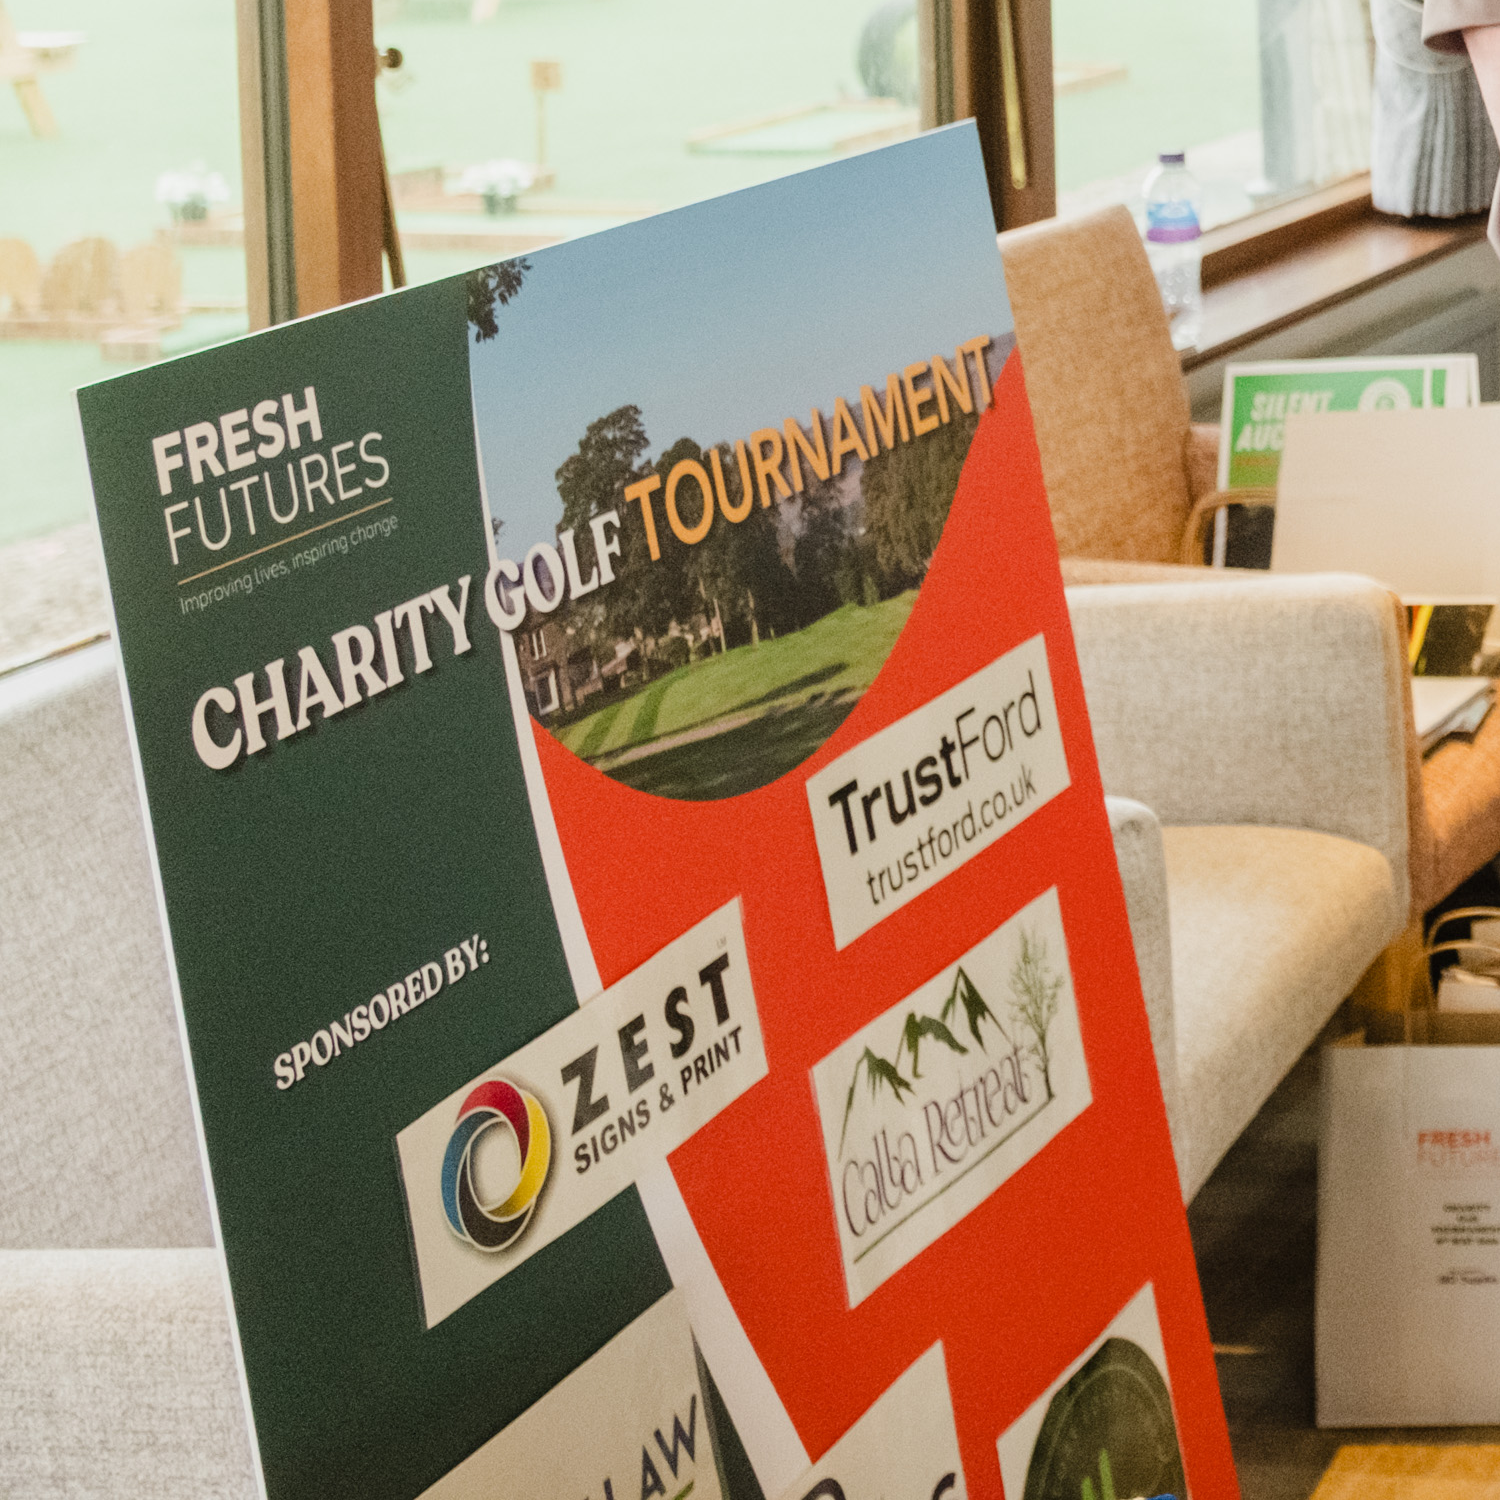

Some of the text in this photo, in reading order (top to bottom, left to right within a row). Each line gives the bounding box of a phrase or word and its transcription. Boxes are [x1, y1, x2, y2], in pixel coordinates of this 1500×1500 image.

[152, 386, 323, 496] FRESH
[1250, 390, 1334, 421] SILENT
[164, 431, 390, 565] FUTURES
[179, 514, 399, 615] Improving lives, inspiring change
[190, 335, 993, 771] CHARITY GOLF TOURNAMENT
[828, 670, 1042, 856] TrustFord
[866, 765, 1038, 906] trustford.co.uk
[273, 934, 491, 1090] SPONSORED BY:
[560, 952, 731, 1137] ZEST
[573, 1026, 743, 1175] SIGNS & PRINT
[922, 1044, 1031, 1176] Retreat
[1418, 1130, 1491, 1148] FRESH
